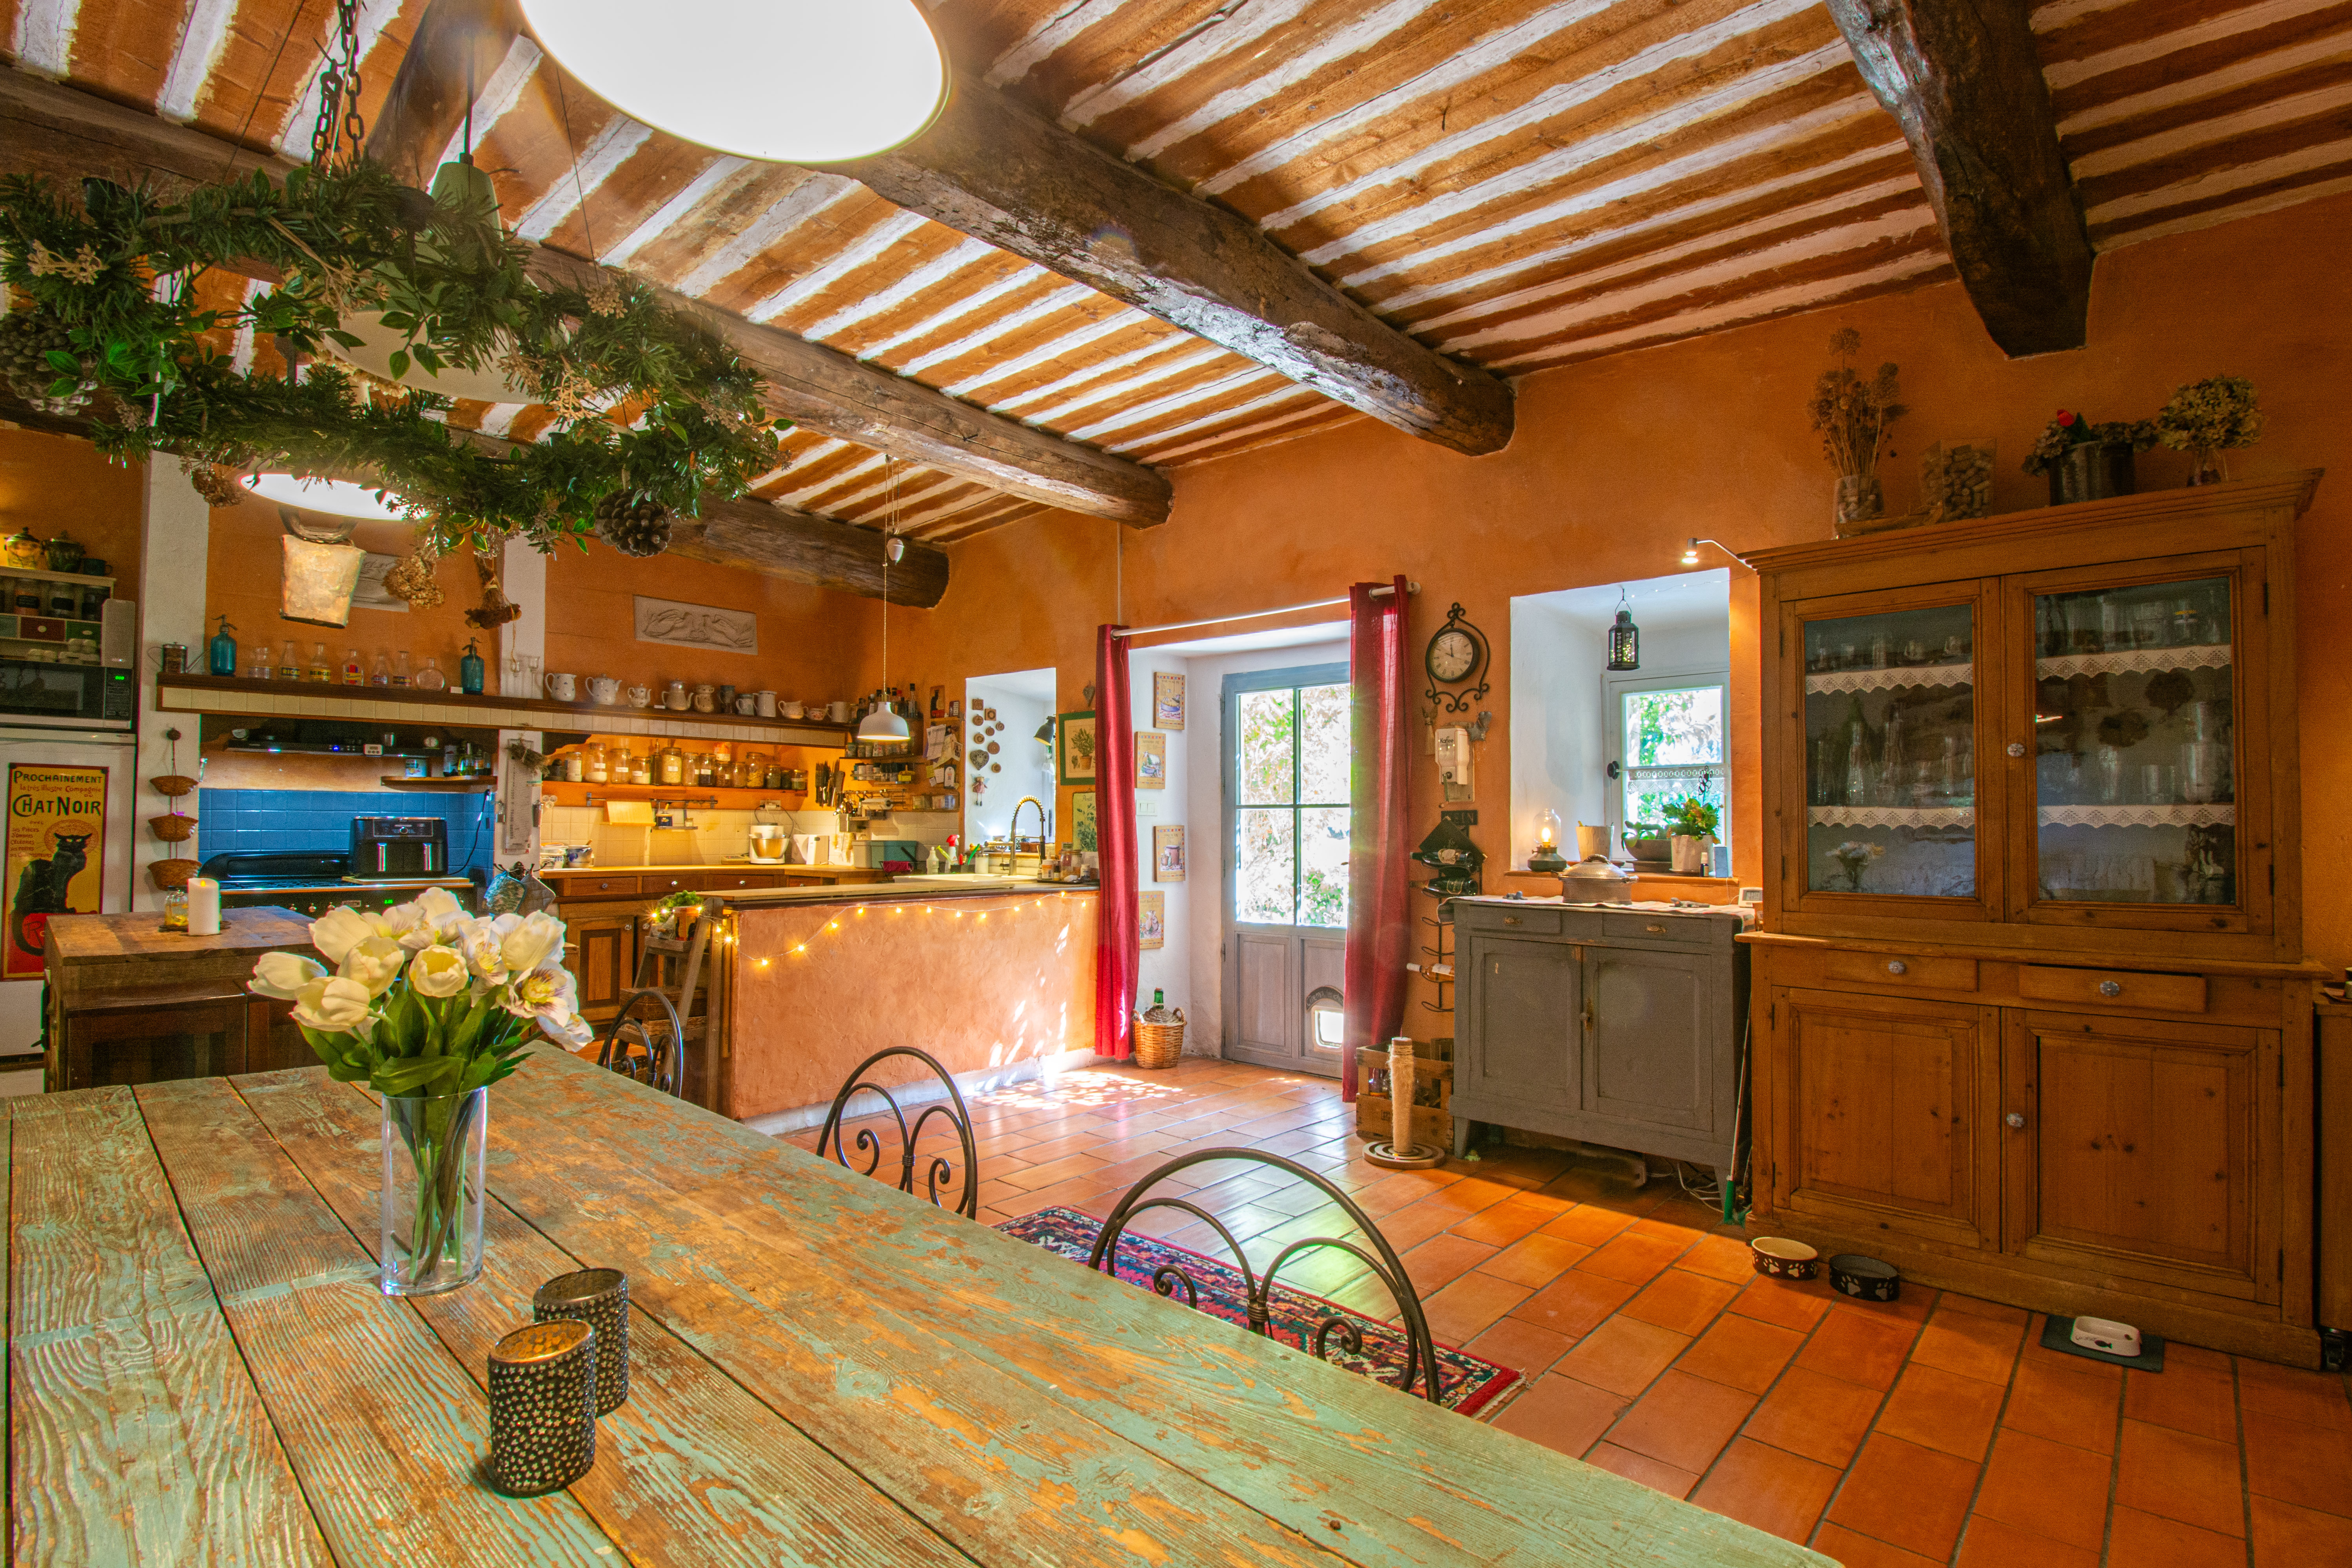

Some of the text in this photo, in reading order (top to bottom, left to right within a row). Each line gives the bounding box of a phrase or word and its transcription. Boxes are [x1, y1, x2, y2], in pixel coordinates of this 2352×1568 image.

[14, 770, 103, 784] PROCHAINEMENT
[65, 786, 102, 794] Compagnie
[13, 794, 102, 817] CHAT NOIR
